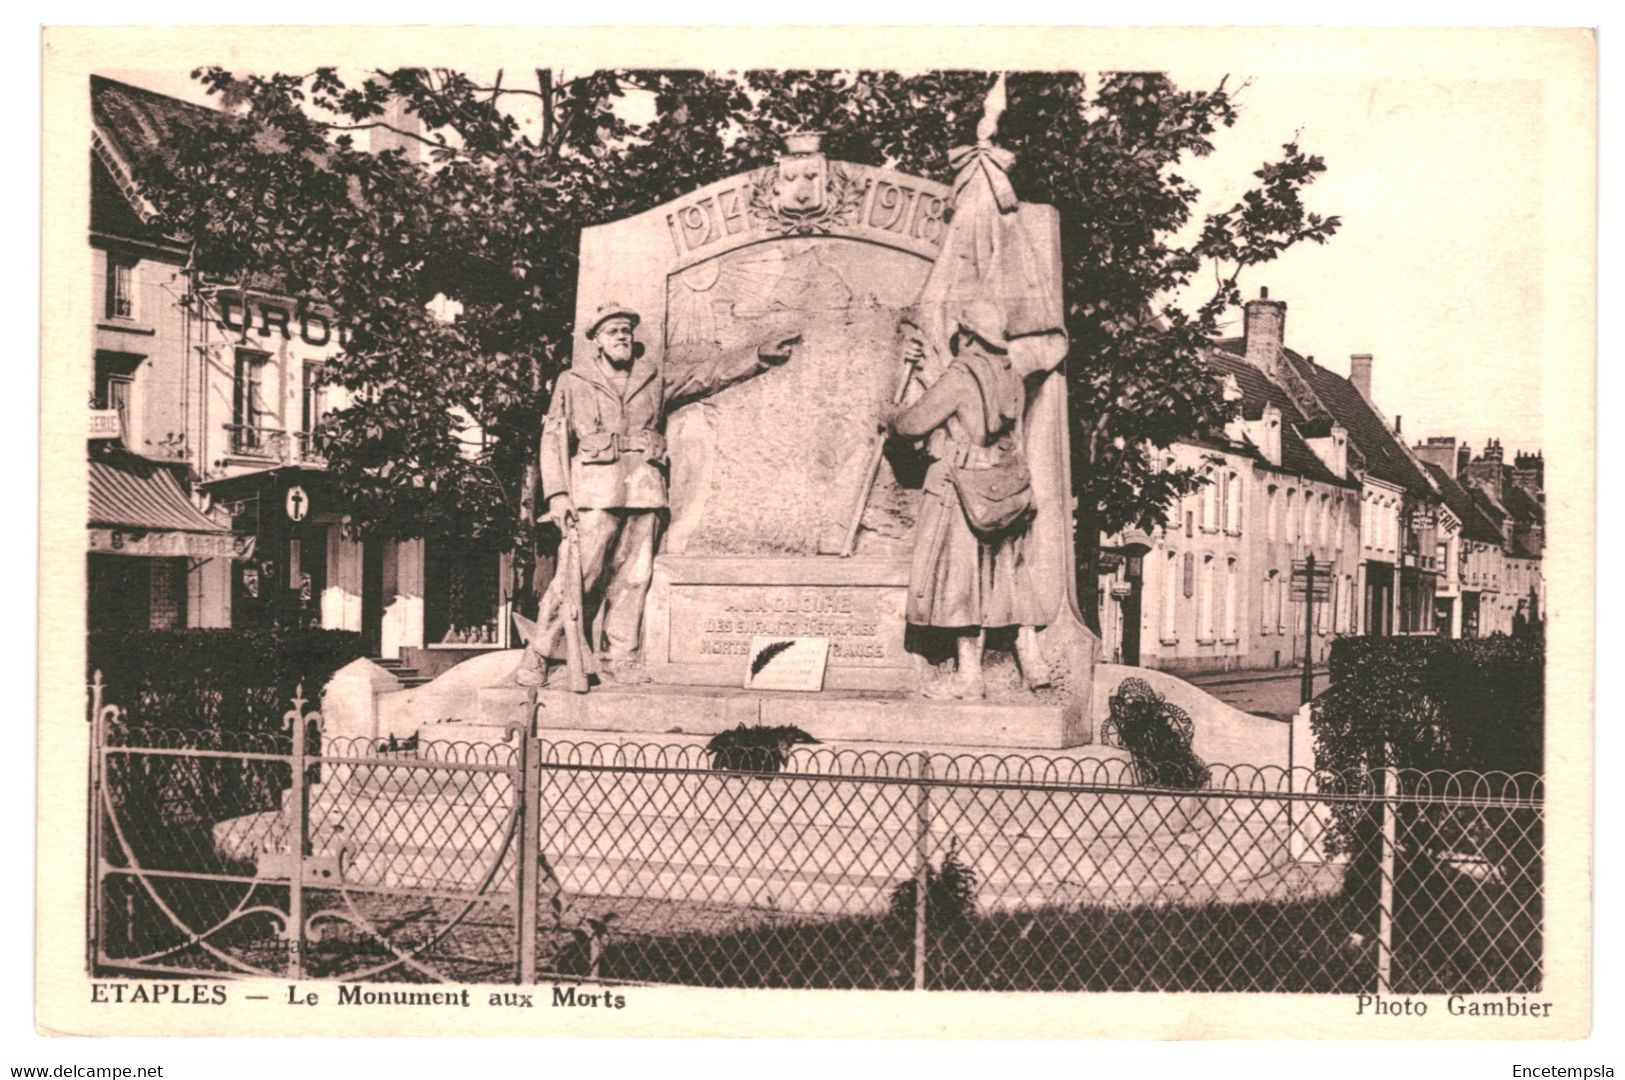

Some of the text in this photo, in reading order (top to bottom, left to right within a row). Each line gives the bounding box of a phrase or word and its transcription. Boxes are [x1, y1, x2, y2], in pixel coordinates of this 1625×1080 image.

[667, 177, 948, 257] 1914 1918
[736, 620, 797, 635] ENFANTS
[829, 642, 885, 658] RANCE
